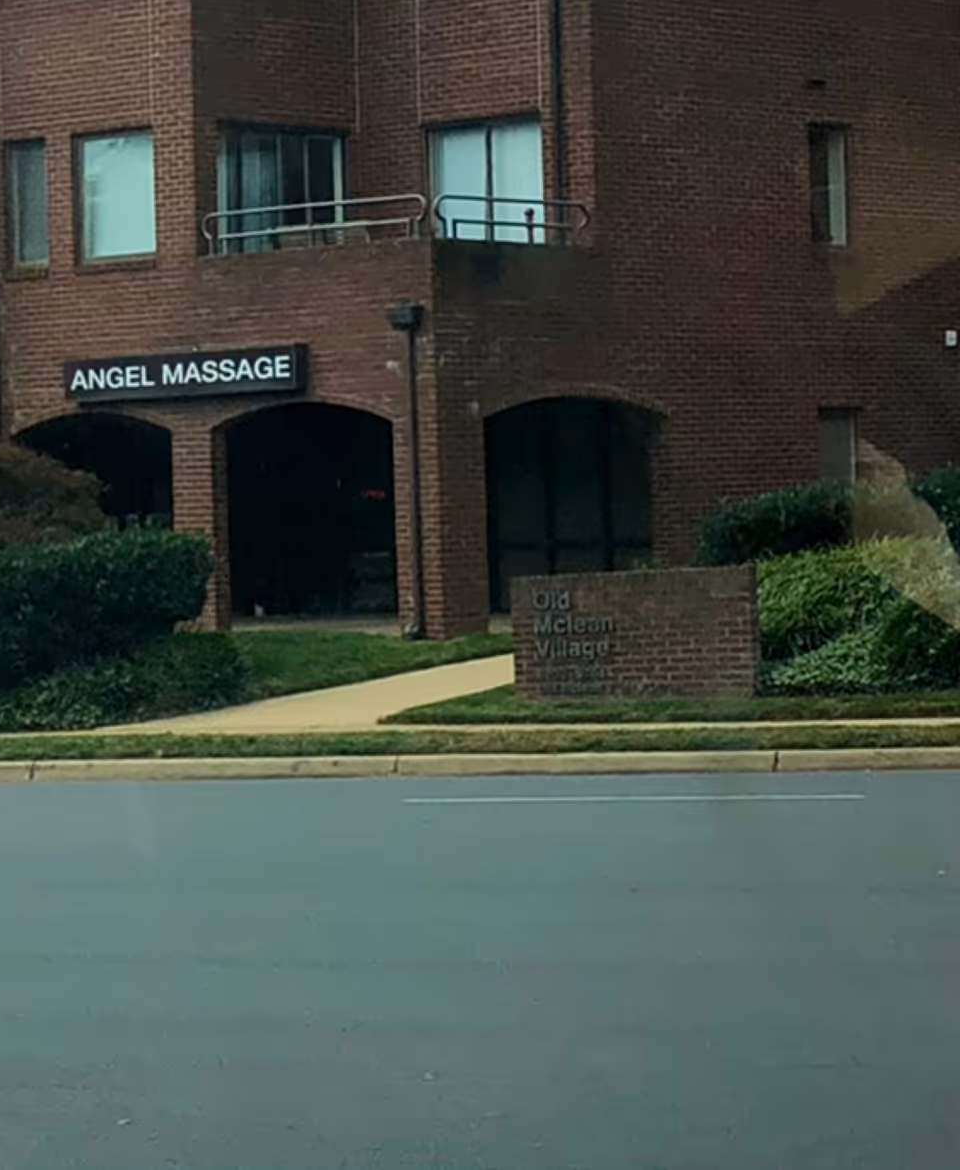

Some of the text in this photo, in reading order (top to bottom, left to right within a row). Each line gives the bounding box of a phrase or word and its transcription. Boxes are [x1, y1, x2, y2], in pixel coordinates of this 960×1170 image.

[70, 355, 291, 391] ANGEL MASSAGE
[532, 590, 571, 610] Old
[535, 637, 611, 660] Village
